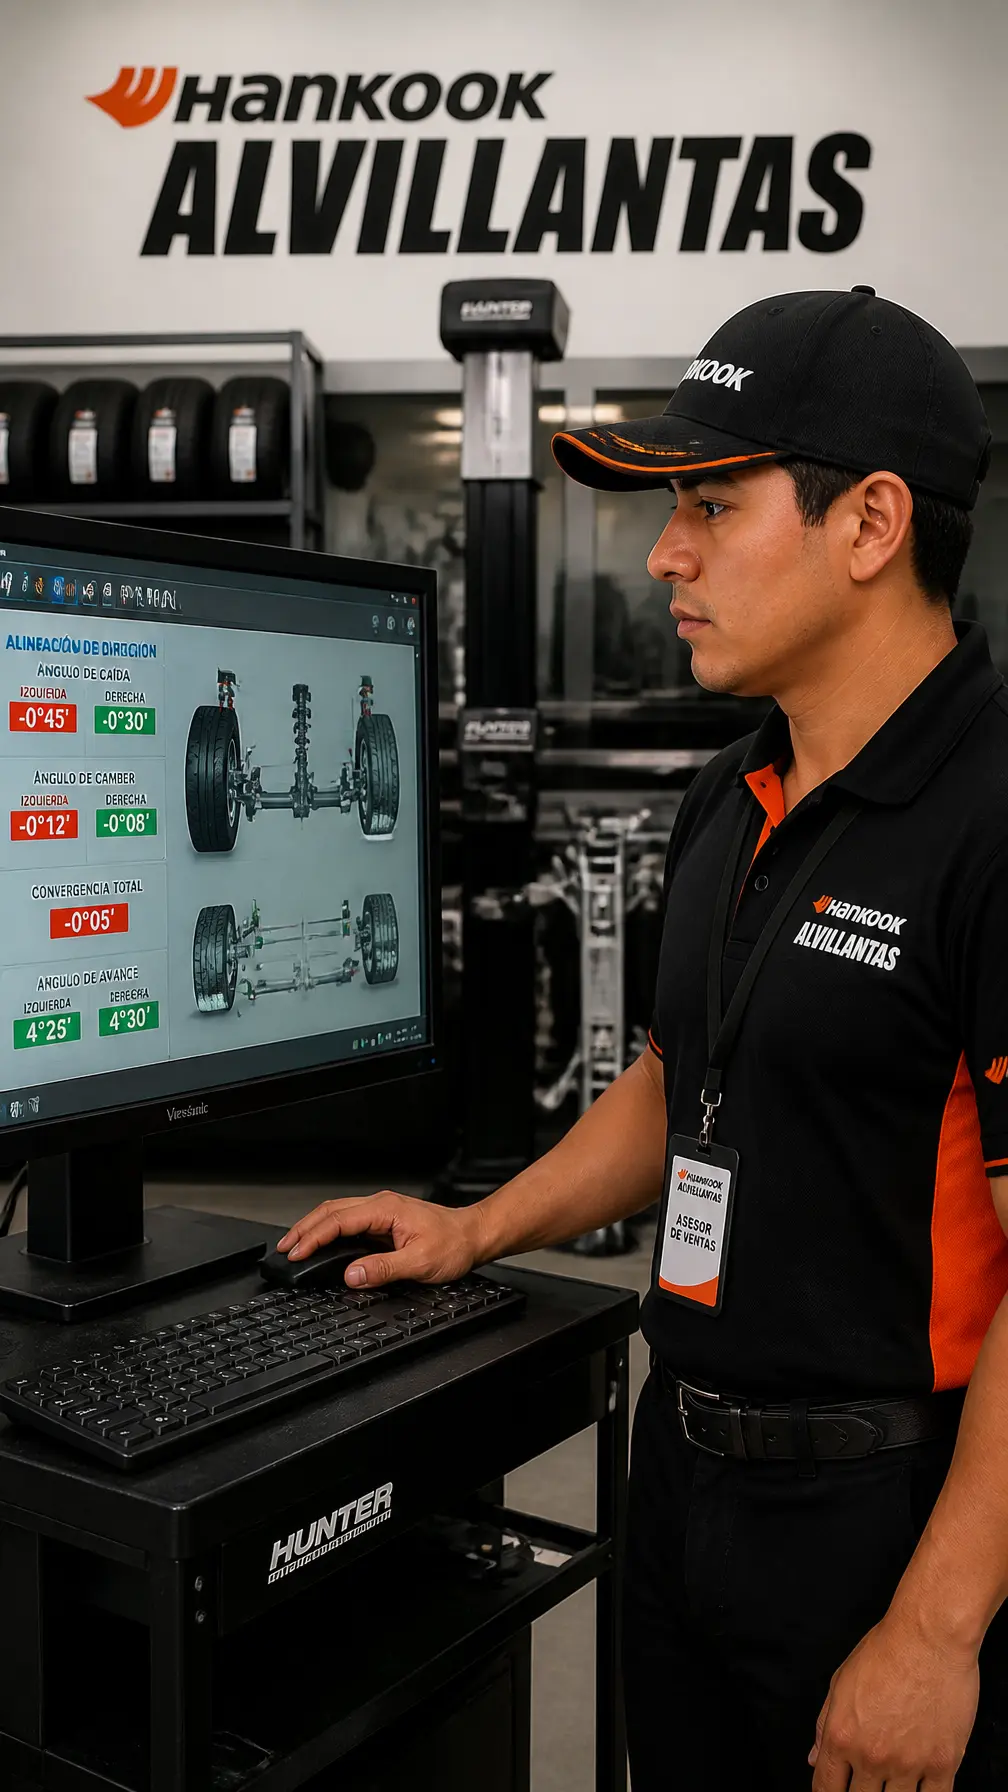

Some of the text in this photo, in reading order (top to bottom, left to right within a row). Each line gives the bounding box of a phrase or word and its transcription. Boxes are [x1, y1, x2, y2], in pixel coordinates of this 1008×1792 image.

[140, 132, 872, 256] ALVILLANTAS
[84, 639, 99, 656] DE
[83, 667, 97, 680] DE
[79, 772, 92, 785] DE
[95, 772, 135, 785] CAMBER
[113, 879, 143, 894] TOTAL
[793, 921, 901, 971] ALVILLANTAS
[83, 971, 97, 985] DE
[676, 1213, 712, 1236] ASESOR
[670, 1227, 717, 1252] DE VENTAS
[269, 1481, 393, 1571] HUNTER
